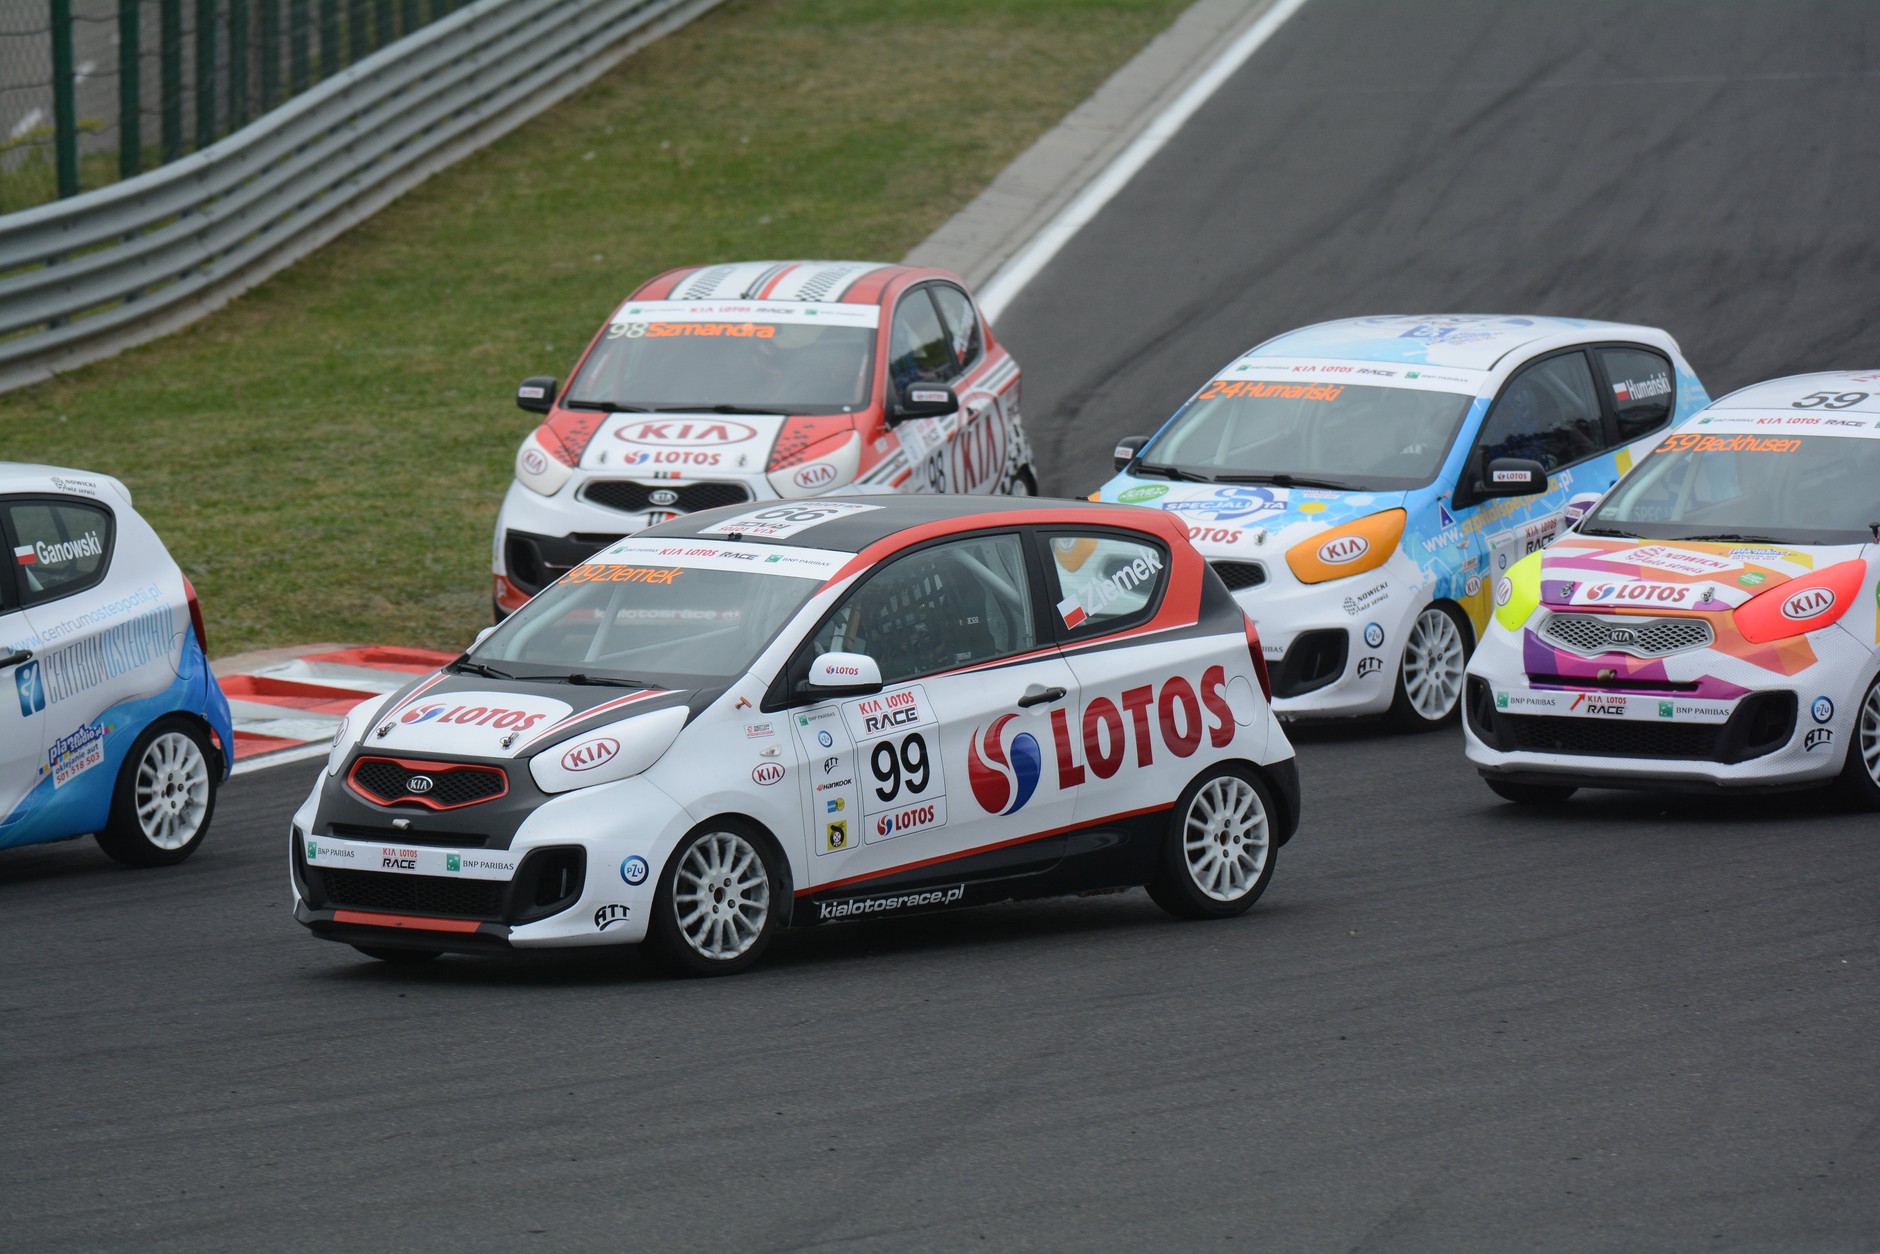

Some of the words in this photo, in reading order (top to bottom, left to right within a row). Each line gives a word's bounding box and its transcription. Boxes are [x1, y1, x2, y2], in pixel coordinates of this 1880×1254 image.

[1356, 368, 1397, 377] RACE
[1625, 372, 1672, 400] Humański
[1792, 391, 1869, 409] 59
[638, 424, 729, 440] KIA
[1823, 419, 1867, 428] RACE
[654, 451, 721, 465] LOTOS
[801, 466, 832, 485] KIA
[652, 493, 675, 502] KIA
[1189, 526, 1243, 544] OTOS
[36, 530, 102, 565] Ganowski
[659, 548, 684, 556] KIA
[684, 548, 719, 557] LOTOS
[719, 551, 759, 561] RACE
[1326, 539, 1362, 559] KIA
[1665, 553, 1729, 569] NOWICKI
[1078, 547, 1164, 617] Ziemek
[1357, 581, 1388, 602] NOWICKI
[1615, 584, 1691, 603] LOTOS
[1790, 591, 1829, 615] KIA
[1611, 631, 1630, 641] KIA
[835, 666, 860, 676] LOTOS
[859, 699, 882, 715] KIA
[886, 691, 915, 708] LOTOS
[1526, 698, 1556, 707] PARIBAS
[1587, 695, 1602, 703] KIA
[1607, 696, 1627, 705] LOTOS
[1587, 704, 1625, 715] RACE
[1676, 706, 1693, 714] BNP
[1694, 707, 1730, 716] PARIBAS
[436, 705, 547, 732] LOTOS
[866, 706, 918, 734] RACE
[1050, 665, 1236, 790] LOTOS
[87, 743, 99, 755] aut
[569, 741, 612, 768] KIA
[56, 769, 69, 784] 501
[71, 760, 84, 775] 518
[86, 752, 100, 765] 503
[757, 766, 780, 782] KIA
[871, 732, 930, 802] 99
[410, 778, 428, 790] KIA
[895, 805, 935, 831] LOTOS
[318, 847, 330, 855] BNP
[331, 850, 355, 858] PARIBAS
[383, 848, 396, 856] KIA
[400, 850, 418, 858] LOTOS
[382, 858, 416, 870] RACE
[463, 860, 479, 868] BNP
[480, 861, 514, 871] PARIBAS
[819, 883, 965, 919] kialotosrace.pl
[594, 903, 631, 929] ATT
